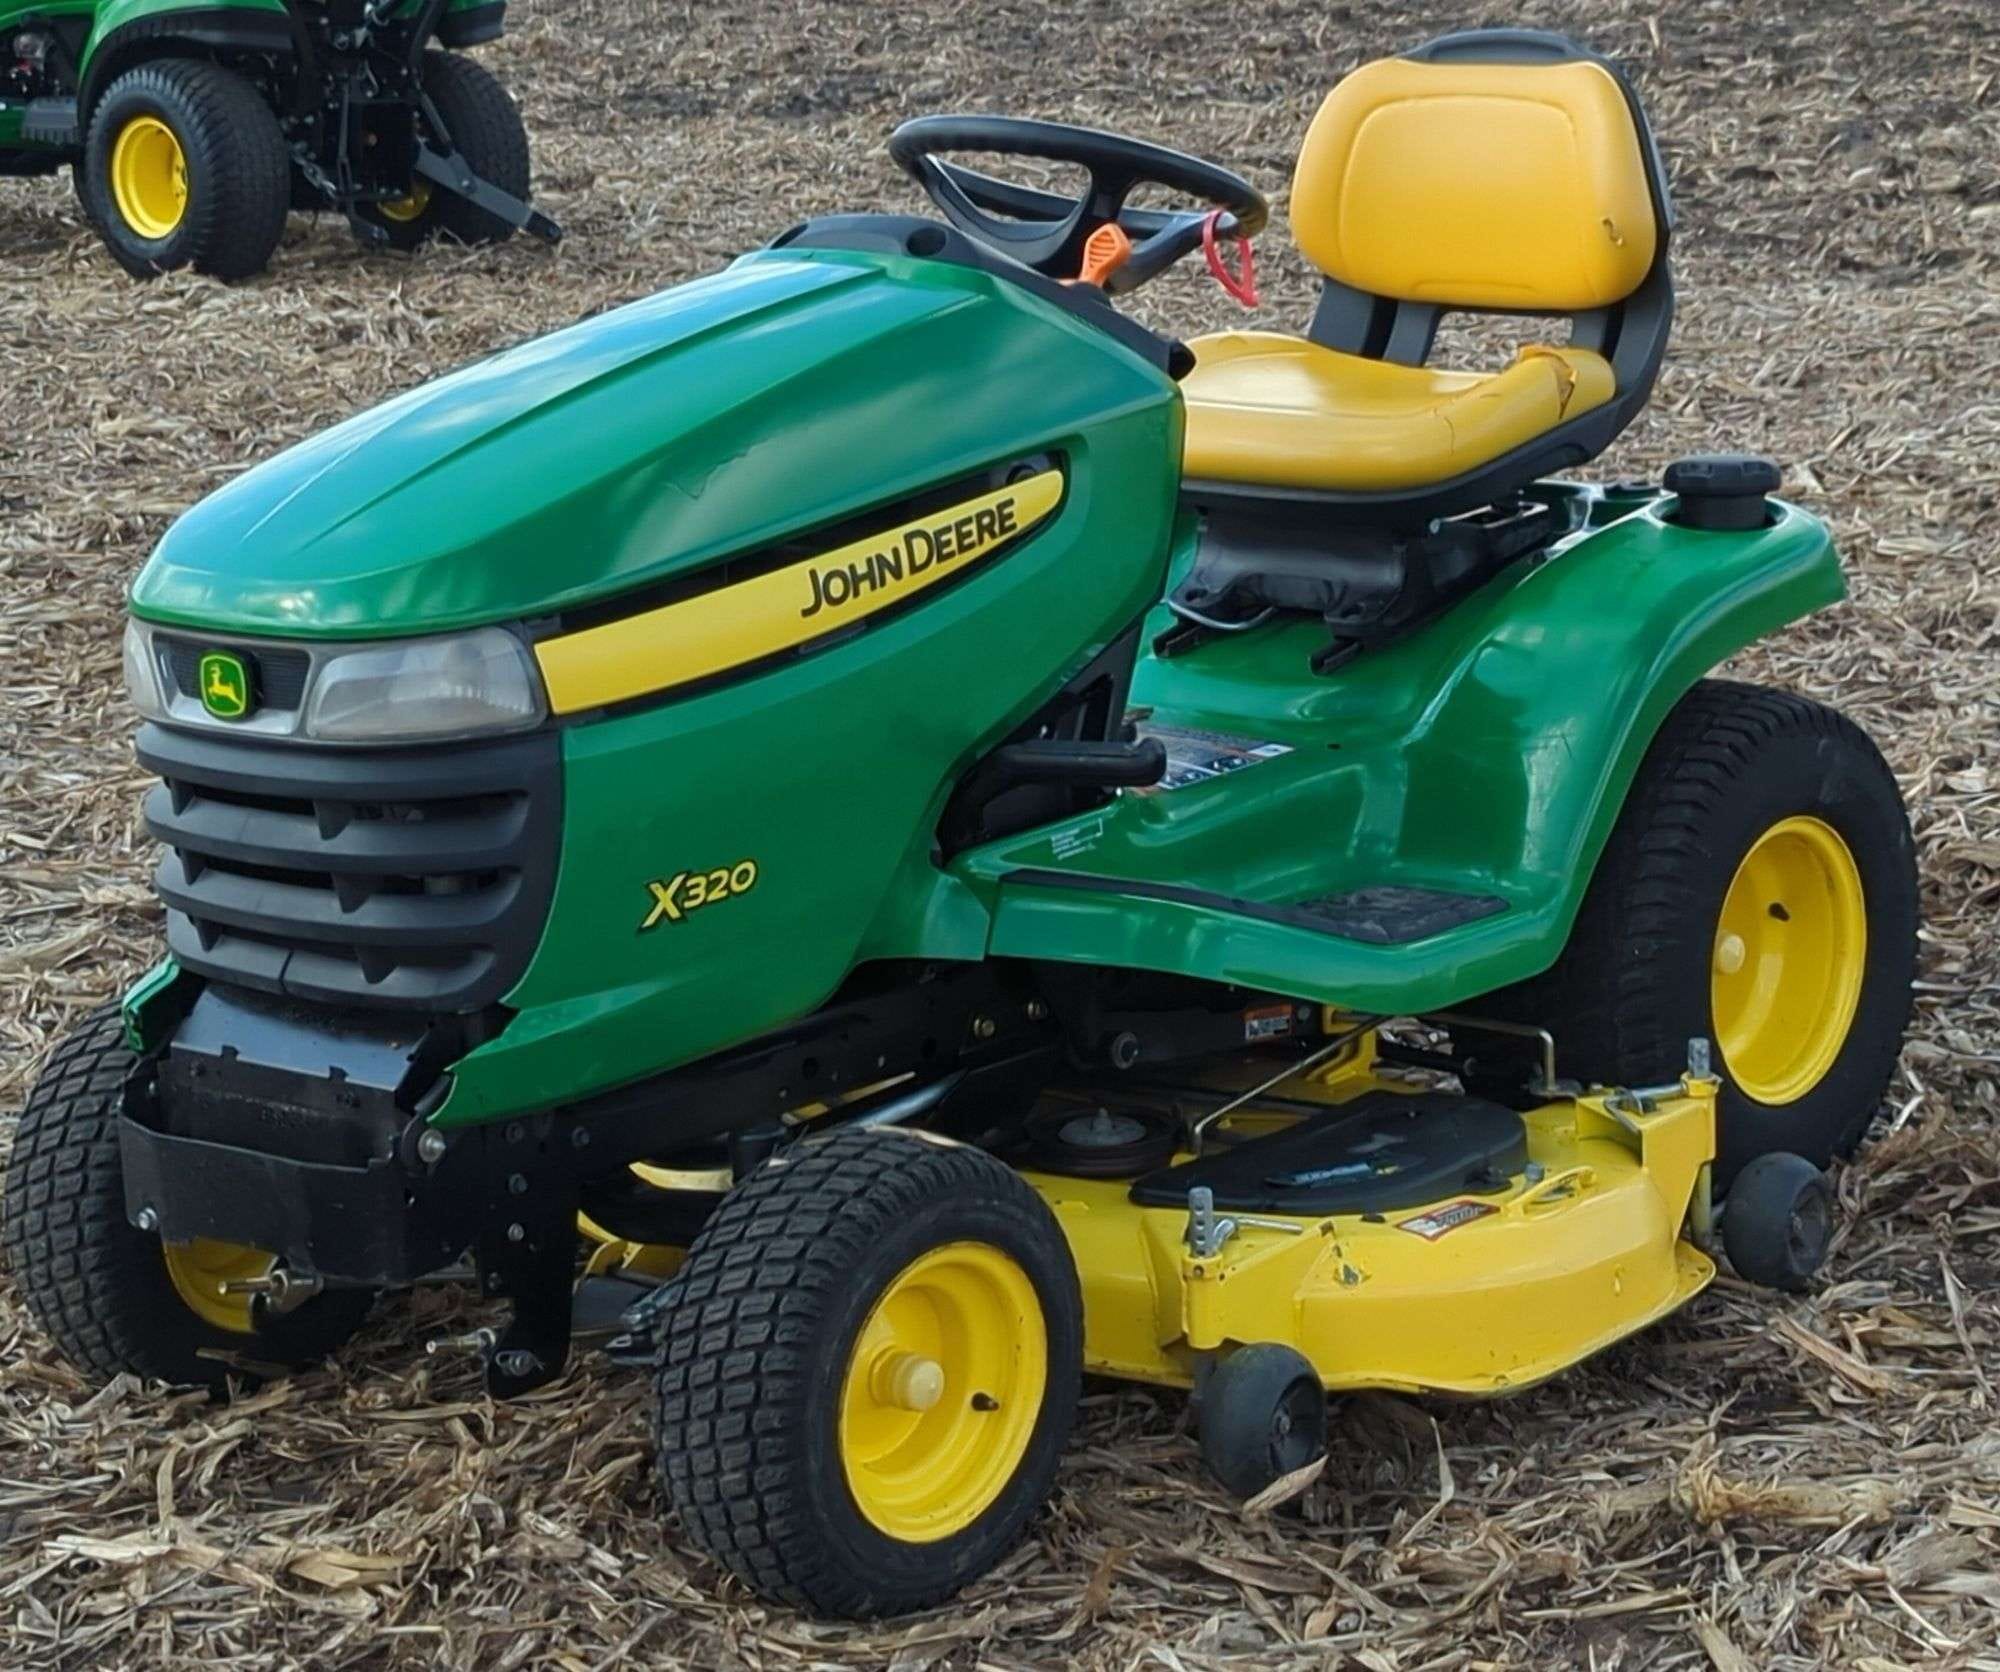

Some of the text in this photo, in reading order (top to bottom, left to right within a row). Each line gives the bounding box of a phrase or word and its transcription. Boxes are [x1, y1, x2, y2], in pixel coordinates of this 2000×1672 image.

[801, 498, 1018, 618] JOHN DEERE
[640, 860, 757, 930] X320
